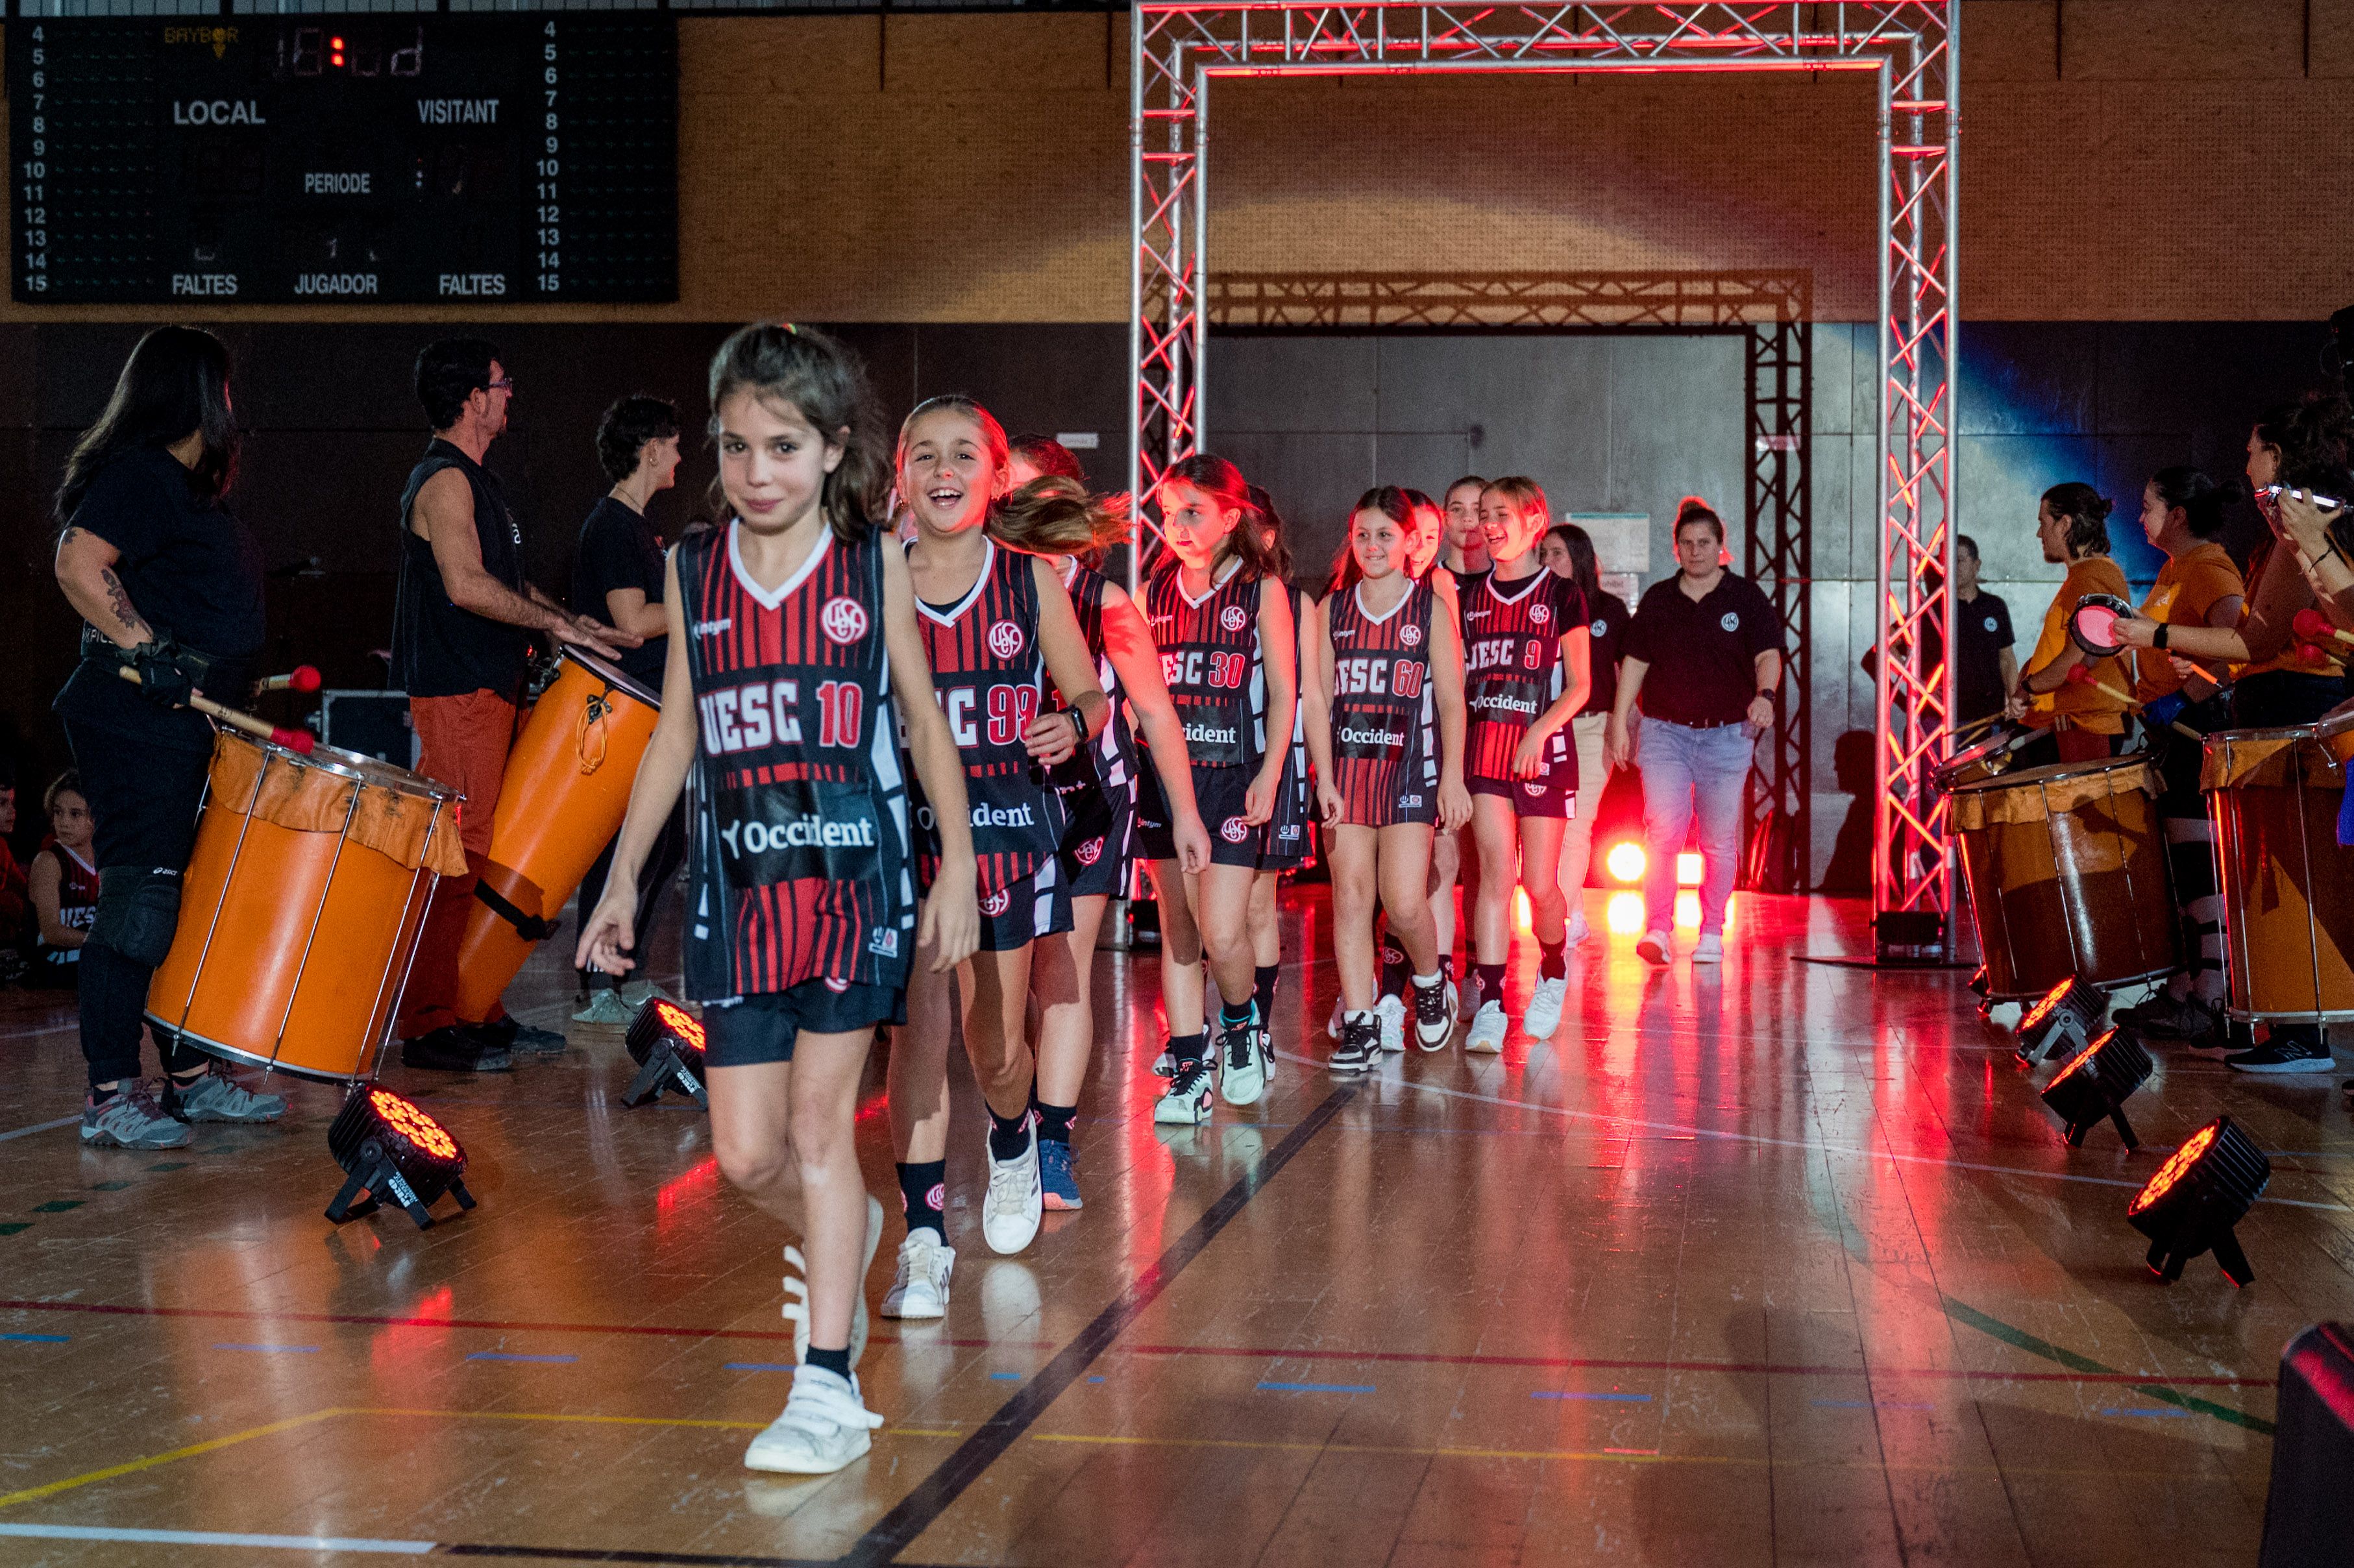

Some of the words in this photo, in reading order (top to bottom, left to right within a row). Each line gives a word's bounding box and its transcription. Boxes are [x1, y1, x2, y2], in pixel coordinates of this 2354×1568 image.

[32, 25, 45, 42] 4
[544, 21, 556, 38] 4
[32, 48, 45, 65] 5
[544, 43, 557, 61] 5
[32, 71, 45, 88] 6
[545, 66, 558, 84] 6
[32, 93, 45, 110] 7
[545, 90, 558, 107] 7
[173, 100, 266, 125] LOCAL
[417, 99, 499, 124] VISITANT
[32, 116, 45, 134] 8
[545, 113, 558, 130] 8
[32, 139, 45, 156] 9
[546, 136, 559, 154] 9
[23, 161, 46, 178] 10
[536, 158, 559, 177] 10
[23, 184, 43, 201] 11
[304, 173, 371, 194] PERIODE
[537, 182, 558, 200] 11
[24, 207, 46, 224] 12
[537, 204, 559, 223] 12
[25, 230, 47, 247] 13
[537, 228, 560, 246] 13
[25, 252, 47, 269] 14
[537, 251, 560, 269] 14
[25, 275, 47, 292] 15
[172, 273, 238, 295] FALTES
[293, 273, 378, 295] JUGADOR
[439, 273, 506, 295] FALTES
[537, 273, 560, 291] 15
[1524, 639, 1541, 670] 9
[1159, 651, 1204, 686] ESC
[1208, 651, 1245, 689] 30
[1392, 659, 1425, 698] 60
[816, 680, 863, 749] 10
[987, 683, 1038, 745] 99
[1341, 727, 1404, 746] Occident
